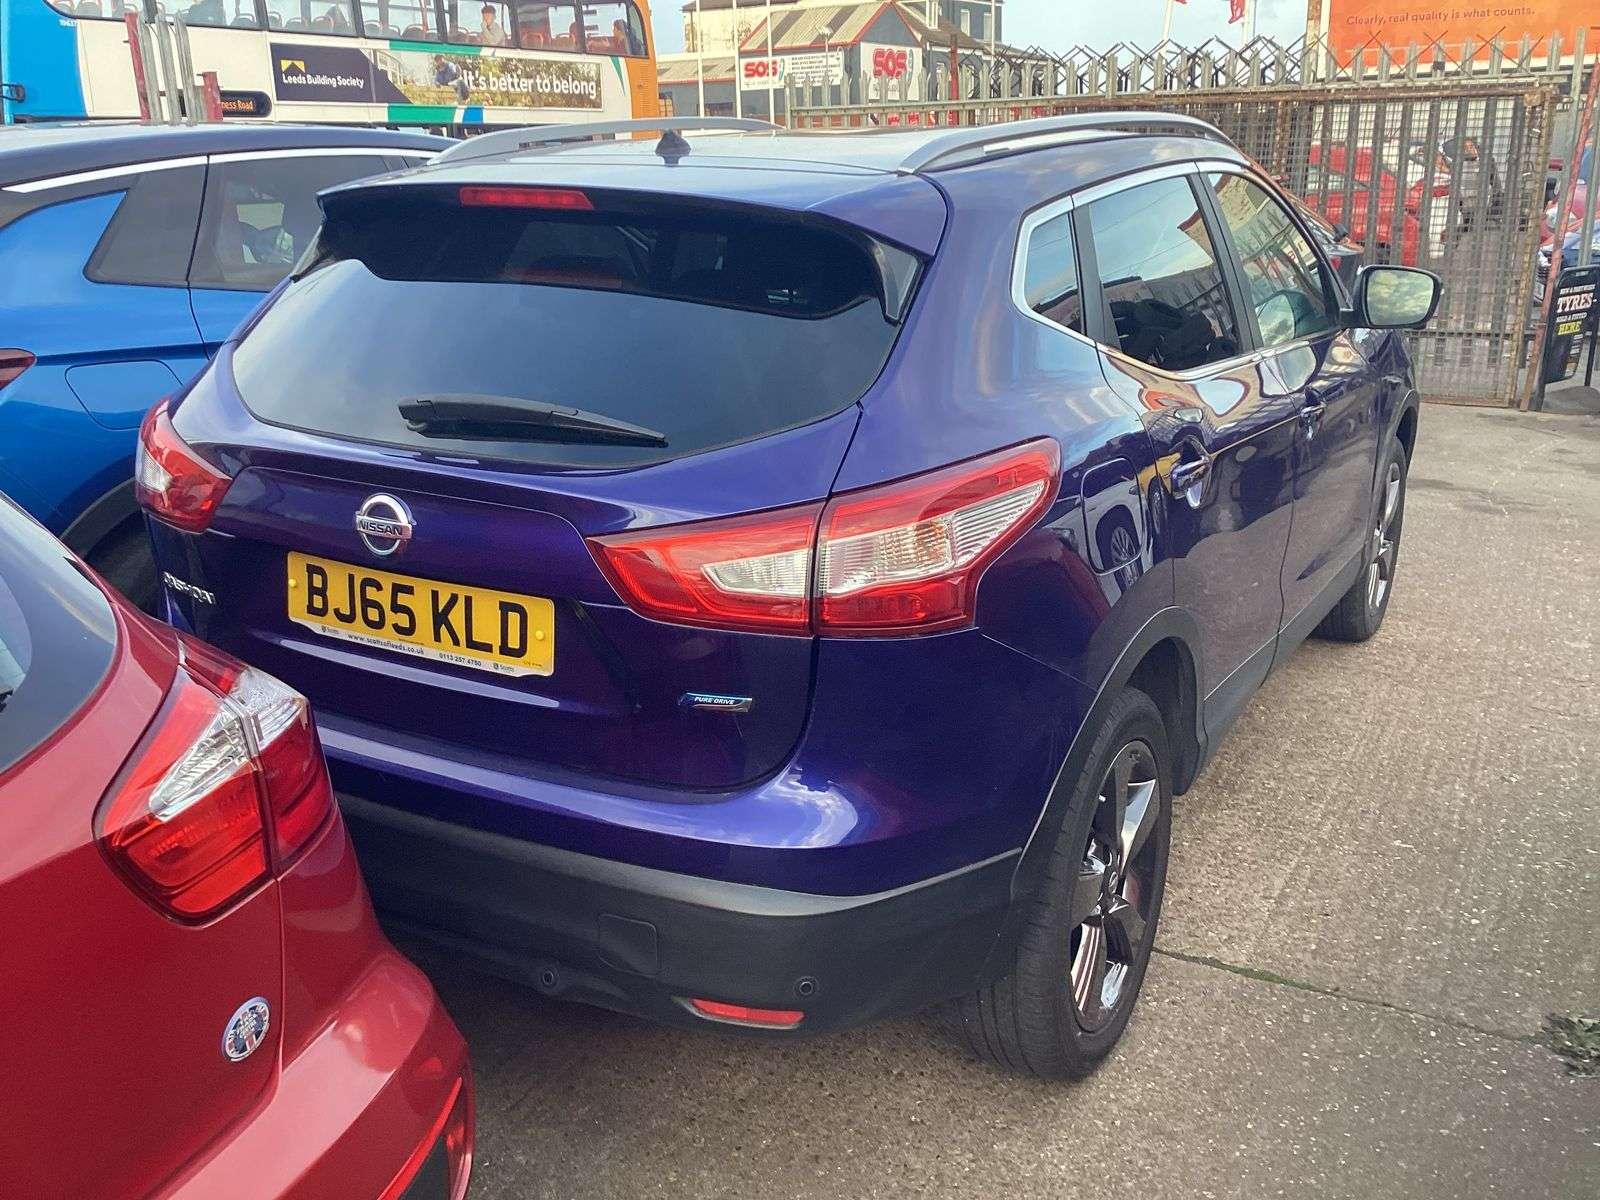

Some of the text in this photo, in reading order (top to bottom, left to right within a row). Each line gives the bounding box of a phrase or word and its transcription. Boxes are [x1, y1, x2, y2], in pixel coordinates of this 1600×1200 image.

[1346, 7, 1535, 25] Clearly, real quality is what counts.
[744, 60, 778, 79] SOS
[873, 48, 907, 80] SOS
[282, 73, 364, 89] Leeds Building Society
[463, 69, 597, 99] It's better to belong
[237, 99, 253, 110] Road
[1556, 292, 1594, 313] TYRES
[1557, 321, 1582, 335] HERE
[358, 520, 403, 537] NISSAN
[306, 563, 416, 636] BJ65
[431, 589, 528, 658] KLD
[694, 696, 713, 704] PURE
